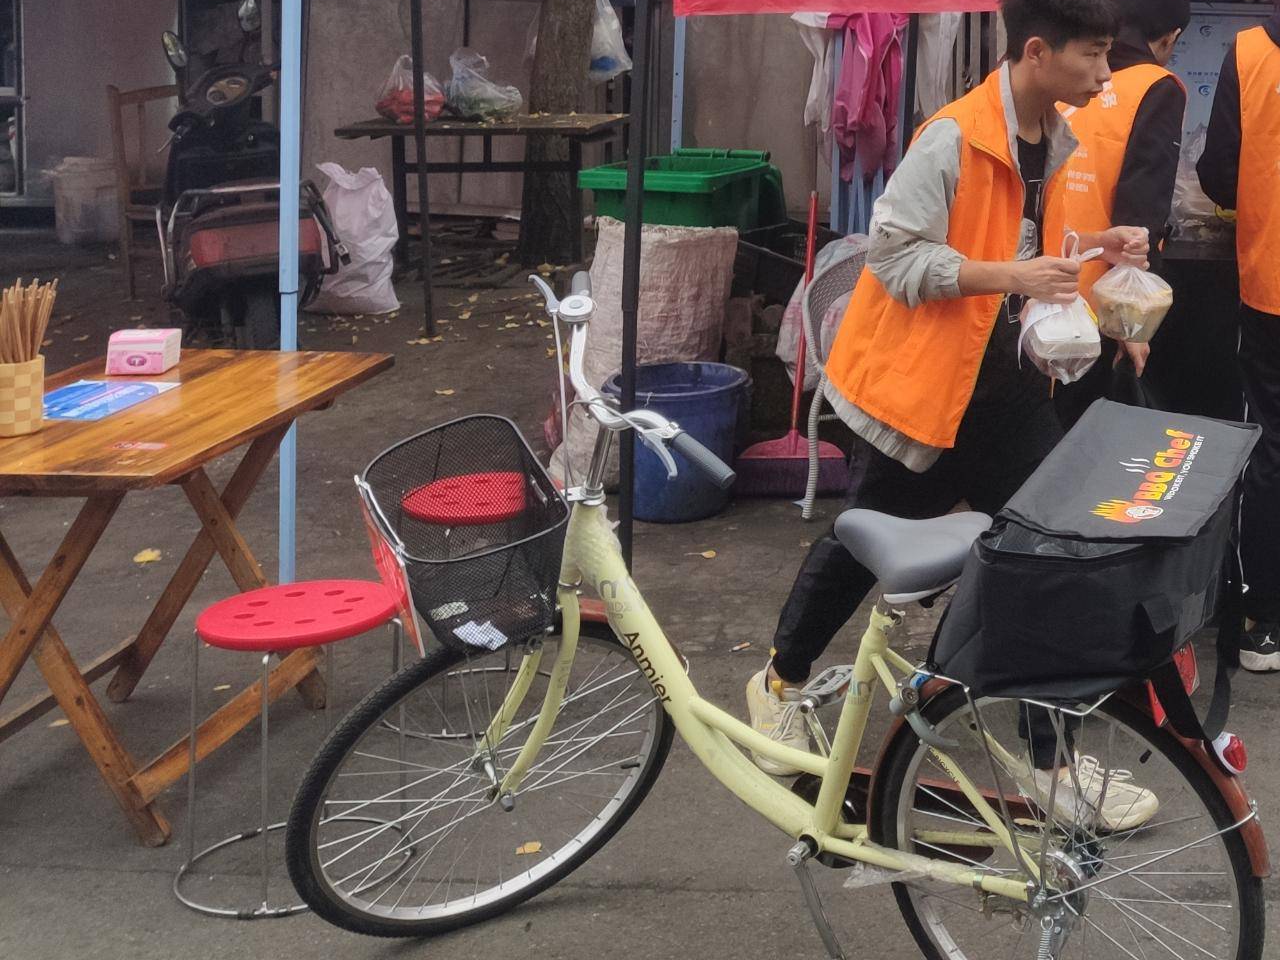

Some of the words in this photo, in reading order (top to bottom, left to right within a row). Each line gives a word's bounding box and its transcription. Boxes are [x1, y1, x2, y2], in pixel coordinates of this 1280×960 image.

[1154, 429, 1194, 468] Chef
[1132, 471, 1177, 501] BBQ
[624, 632, 673, 704] Anmier
